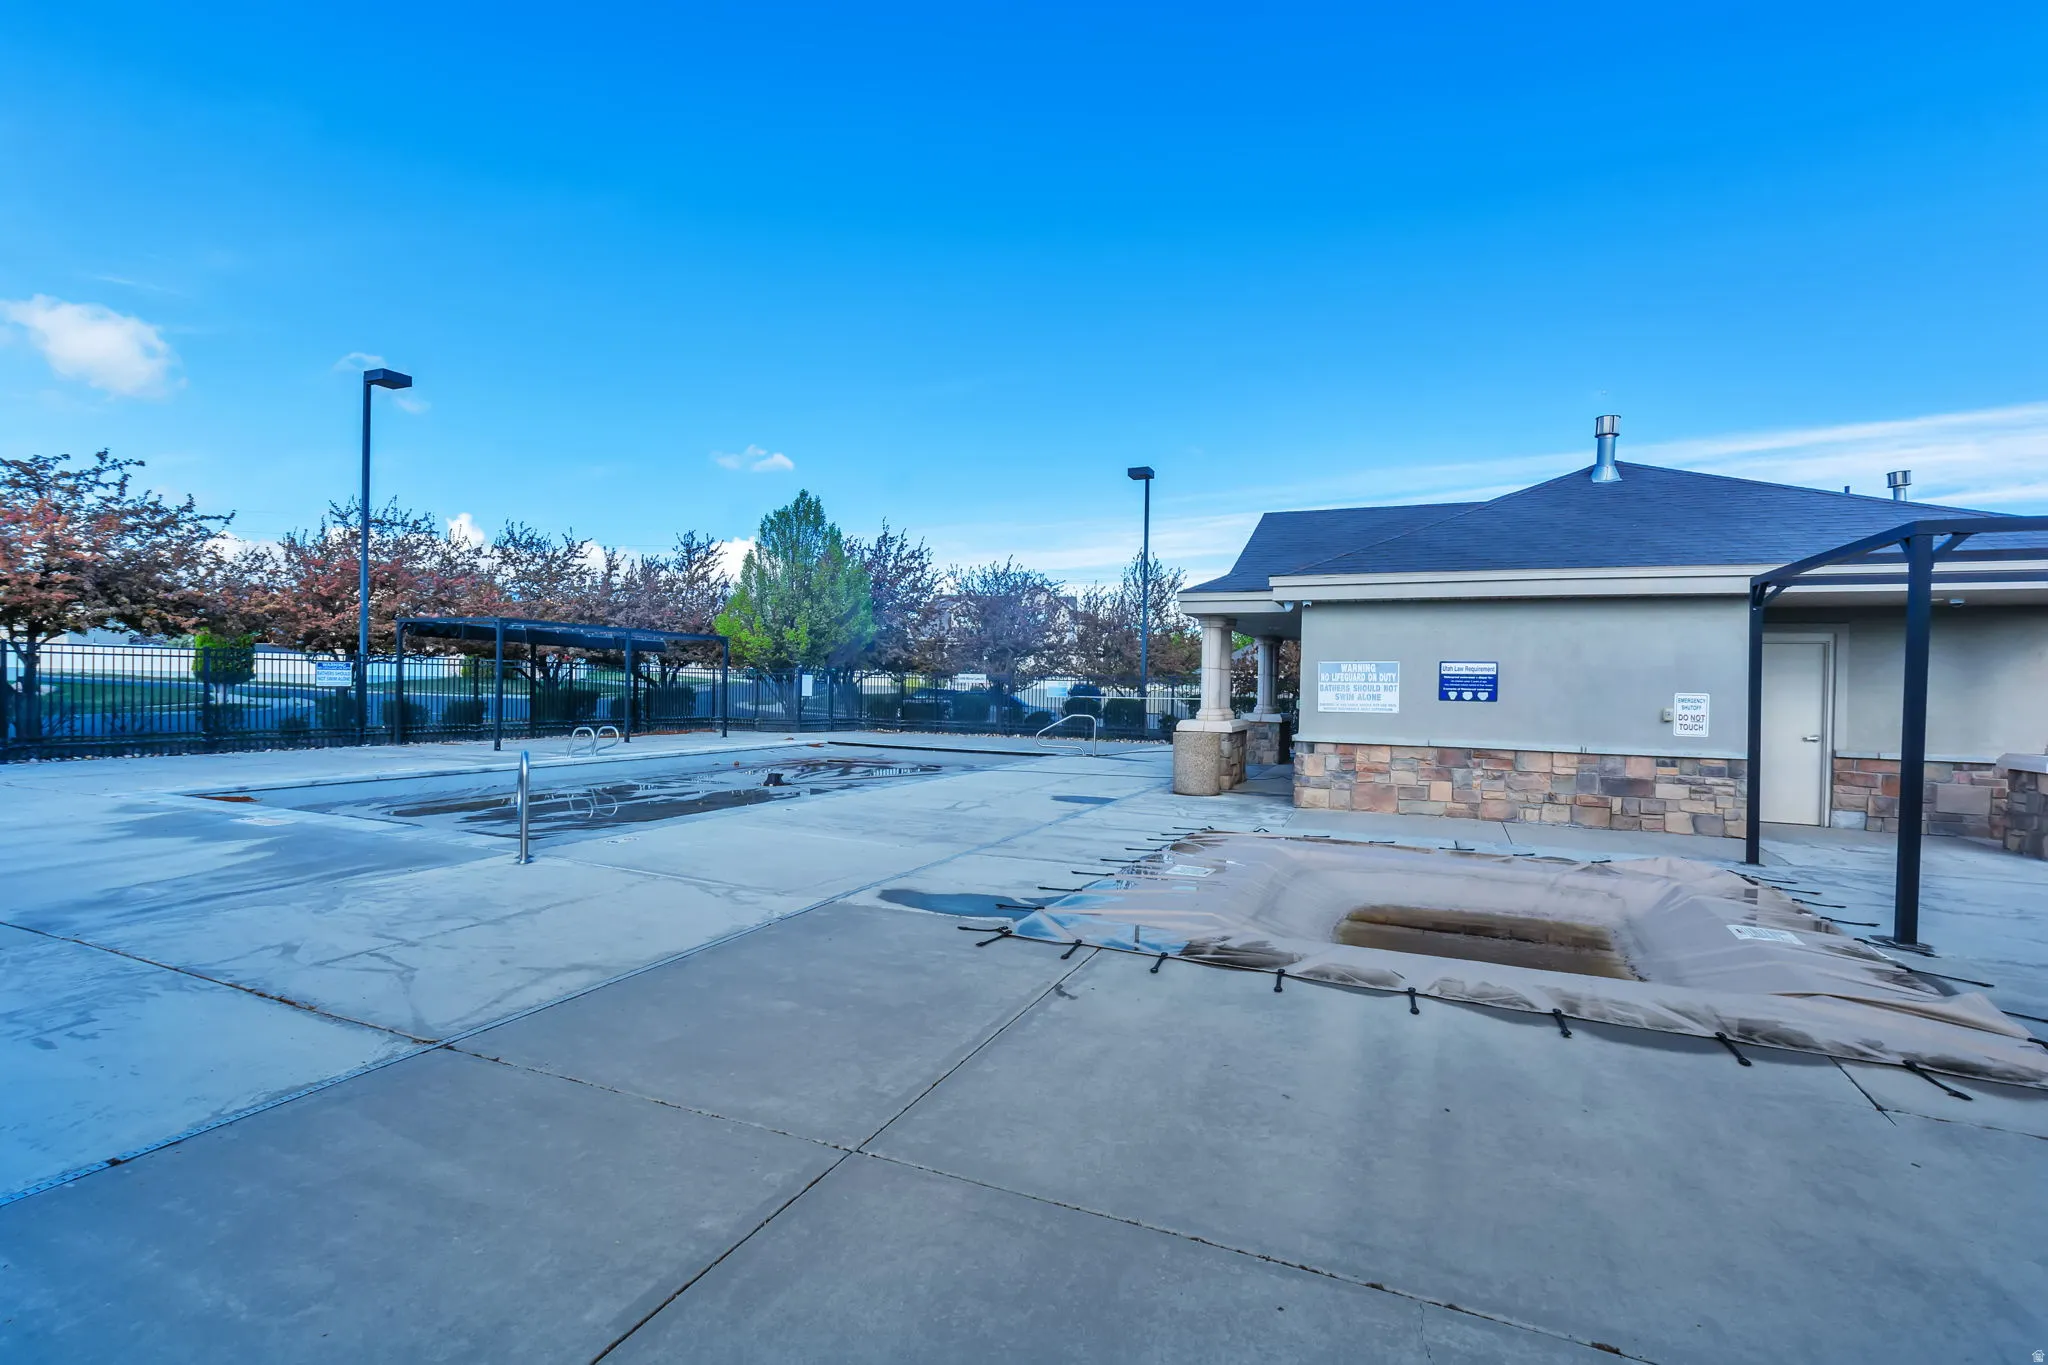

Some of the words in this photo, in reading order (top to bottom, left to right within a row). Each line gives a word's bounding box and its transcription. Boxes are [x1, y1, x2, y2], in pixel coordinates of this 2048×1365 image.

[1341, 664, 1376, 672] WARNING
[1465, 665, 1495, 673] Requirement
[1320, 672, 1330, 682] NO
[1331, 672, 1366, 682] LIFEGUARD
[1368, 672, 1377, 682] ON
[1379, 673, 1397, 682] DUTY
[1320, 684, 1350, 692] BATHERS
[1353, 684, 1381, 692] SHOULD
[1384, 684, 1398, 692] NOT
[1335, 693, 1355, 701] SWIM
[1357, 693, 1383, 701] ALONE
[1690, 714, 1706, 722] NOT
